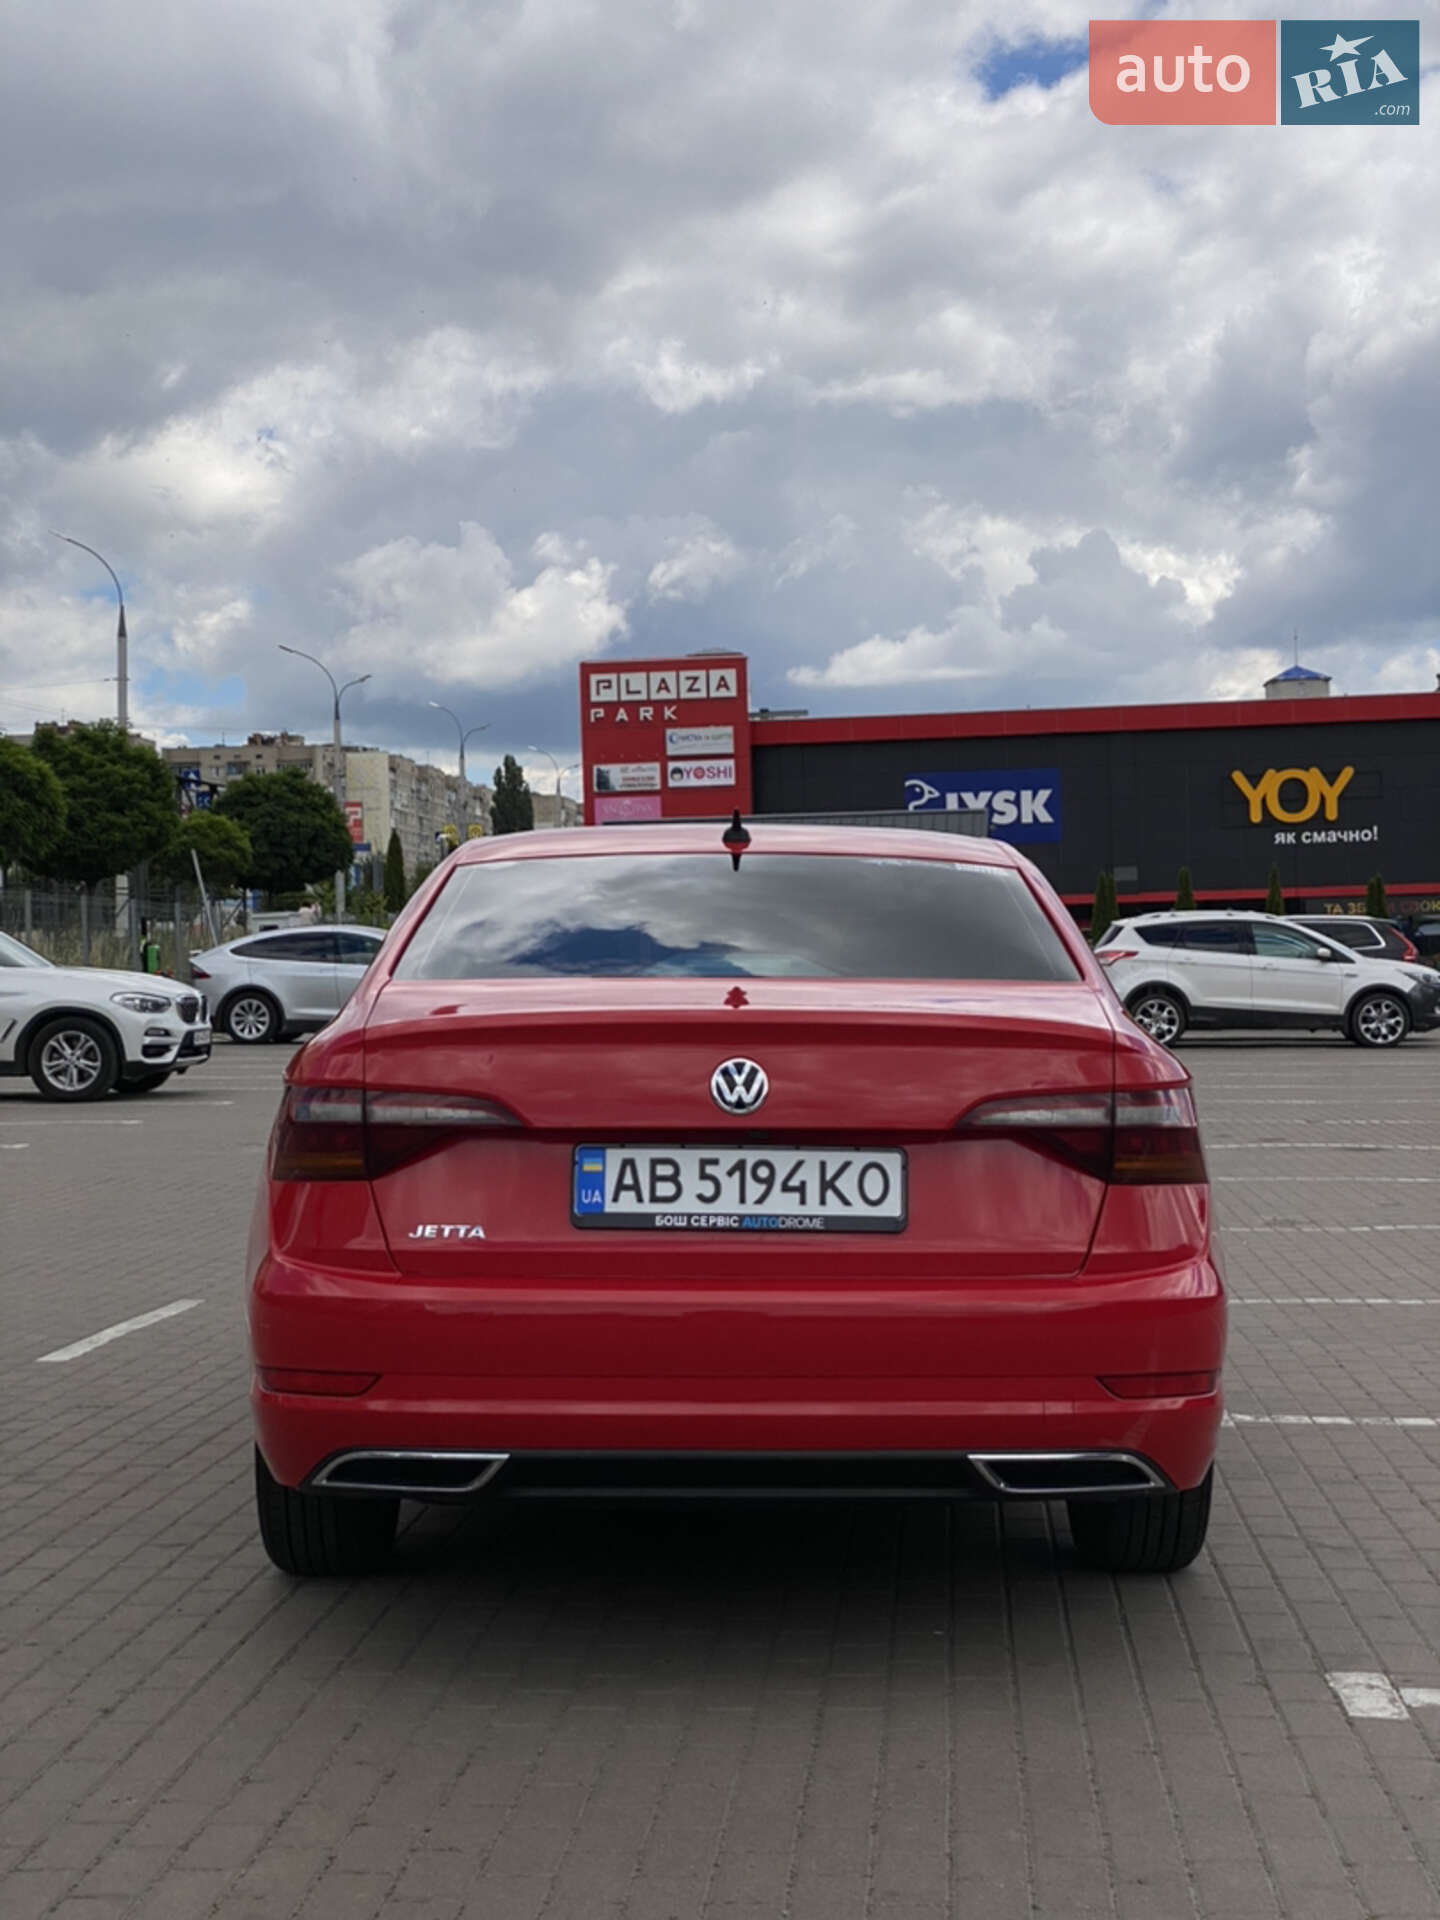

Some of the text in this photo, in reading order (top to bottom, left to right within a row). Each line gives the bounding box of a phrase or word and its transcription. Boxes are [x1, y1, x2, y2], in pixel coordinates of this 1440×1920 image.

[595, 674, 731, 697] PLAZA
[590, 706, 678, 723] PARK
[1231, 766, 1355, 824] YOY
[1274, 825, 1379, 845] як смачно!
[581, 1189, 602, 1204] UA
[655, 1215, 825, 1229] БОШ СЕРВІС AUTODROME
[408, 1224, 486, 1239] JETTA
